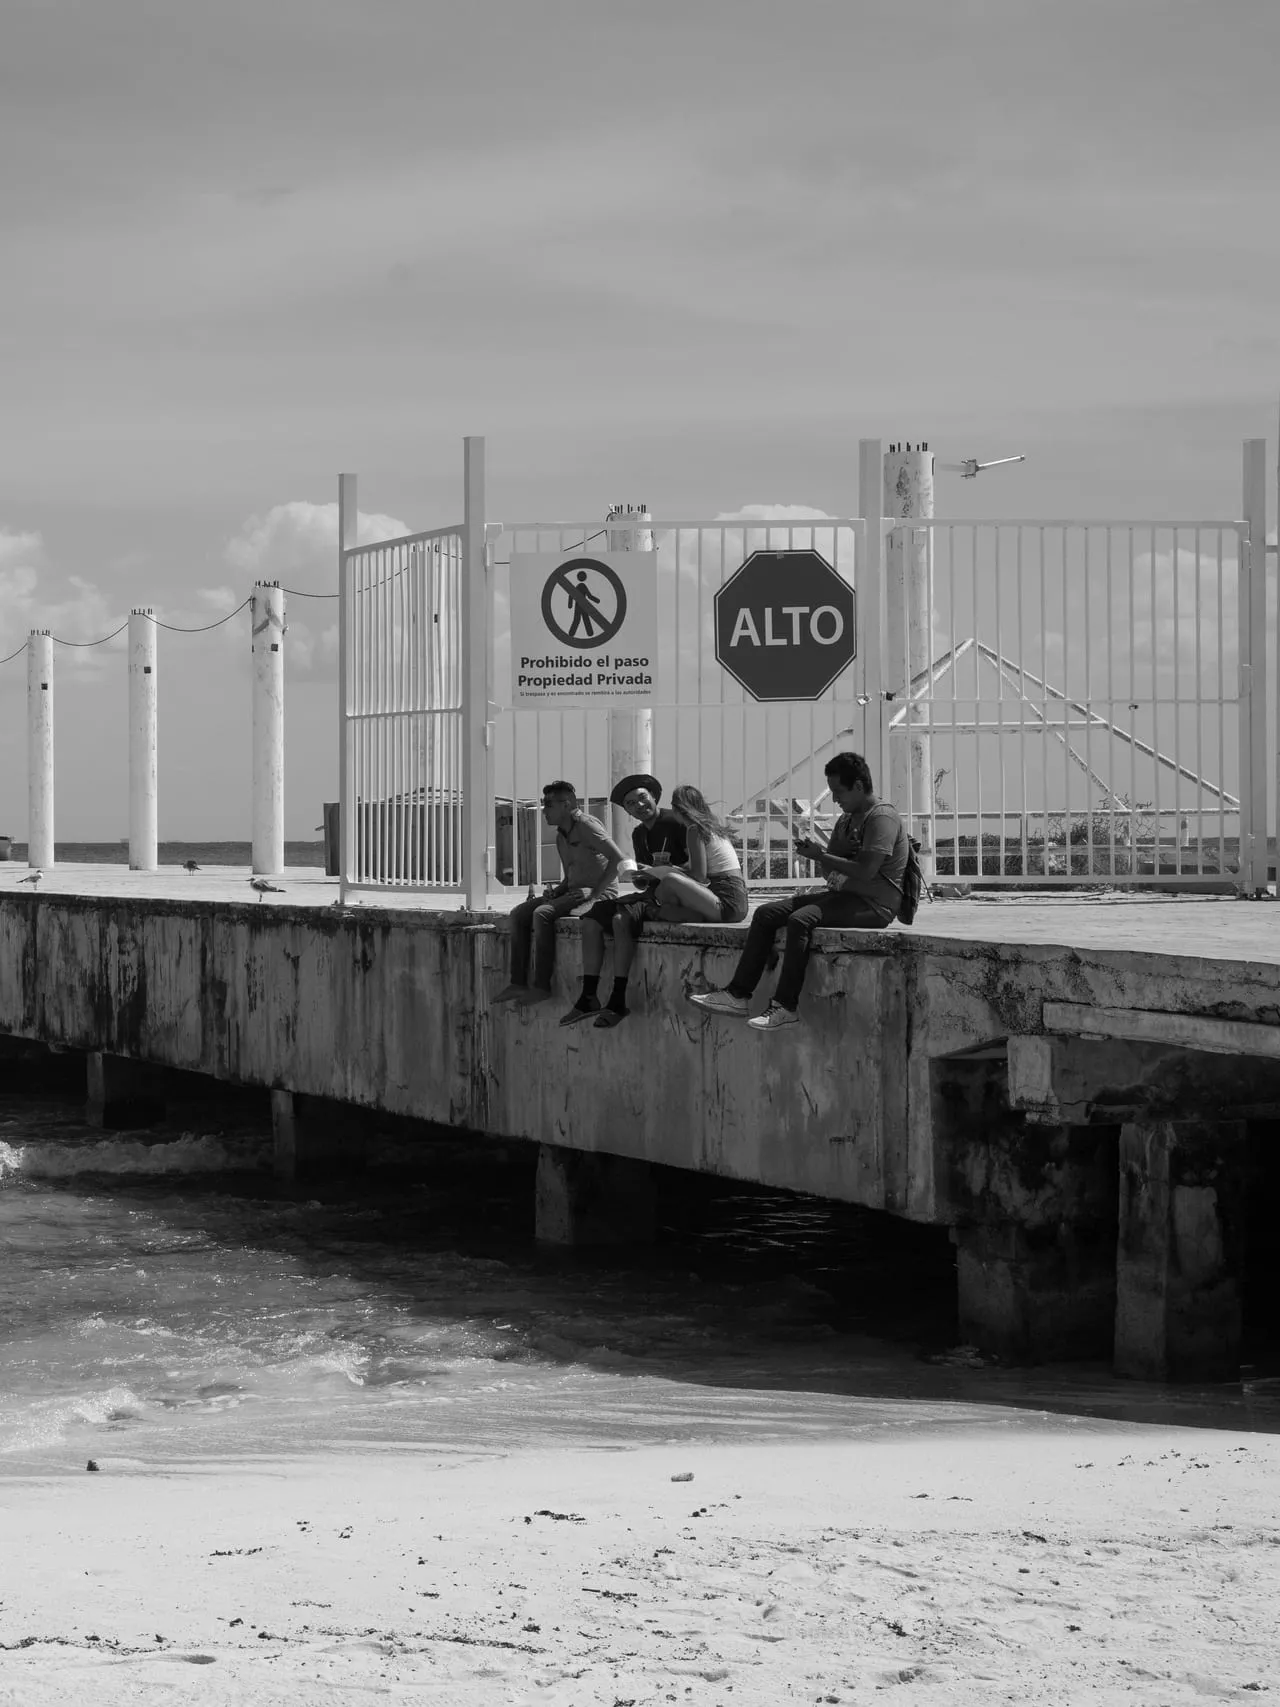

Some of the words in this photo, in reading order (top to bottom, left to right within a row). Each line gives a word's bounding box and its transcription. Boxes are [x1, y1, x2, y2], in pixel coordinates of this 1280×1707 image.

[729, 605, 844, 647] ALTO
[520, 655, 592, 669] Prohibido
[596, 655, 610, 668] el
[614, 657, 649, 670] paso
[518, 673, 593, 689] Propiedad
[597, 672, 652, 686] Privada
